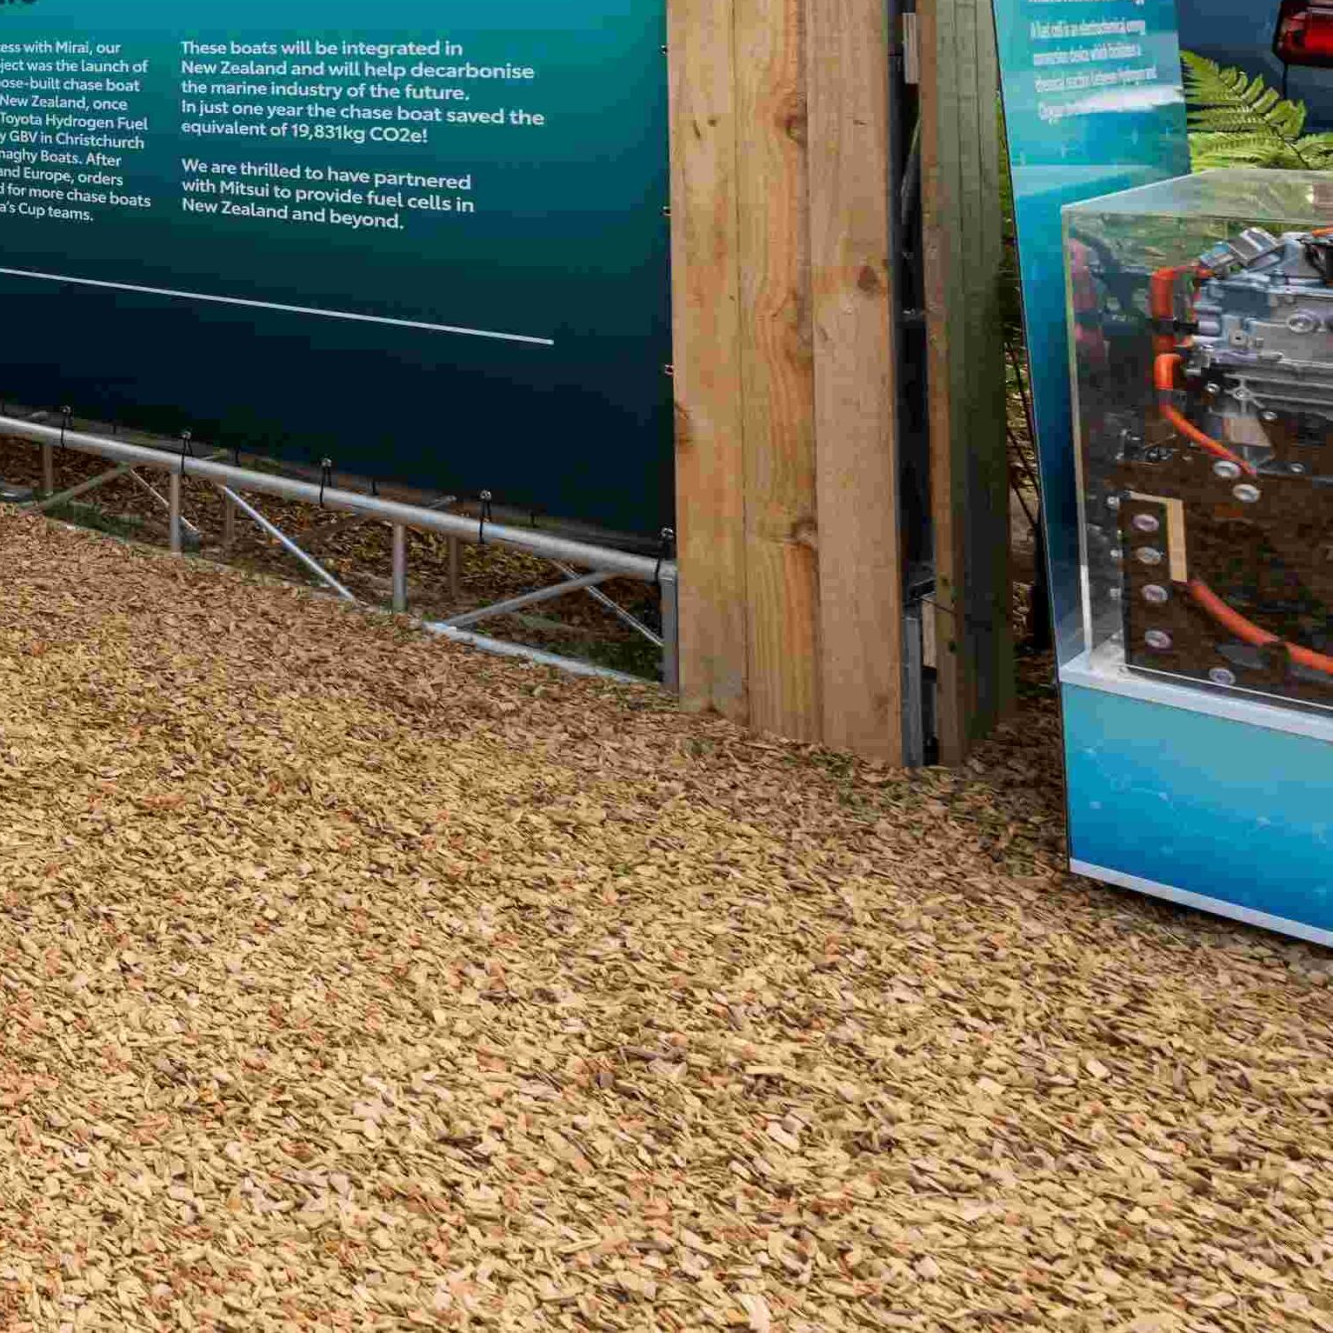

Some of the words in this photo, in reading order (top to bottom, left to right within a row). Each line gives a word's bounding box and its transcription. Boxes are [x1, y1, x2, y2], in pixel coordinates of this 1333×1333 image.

[23, 41, 53, 53] with
[55, 41, 93, 57] Mirai,
[96, 45, 122, 53] our
[181, 41, 227, 54] These
[230, 41, 277, 55] boats
[282, 41, 311, 55] will
[315, 41, 338, 55] be
[342, 41, 440, 59] integrated
[445, 43, 463, 56] in
[27, 62, 53, 71] was
[56, 60, 77, 71] the
[81, 60, 129, 72] launch
[132, 60, 149, 72] of
[181, 61, 216, 74] New
[220, 61, 287, 75] Zealand
[291, 62, 324, 75] and
[328, 62, 361, 76] will
[364, 62, 406, 81] help
[410, 63, 534, 79] decarbonise
[62, 78, 103, 91] chase
[106, 79, 141, 91] boat
[181, 80, 207, 93] the
[210, 83, 268, 95] marine
[271, 82, 342, 101] industry
[346, 84, 366, 97] of
[370, 84, 400, 98] the
[405, 85, 470, 100] future.
[0, 95, 29, 107] New
[31, 96, 91, 112] Zealand,
[93, 101, 128, 110] once
[181, 101, 196, 113] In
[198, 103, 229, 117] just
[232, 105, 263, 115] one
[267, 106, 303, 120] year
[307, 104, 336, 118] the
[340, 105, 393, 120] chase
[397, 106, 442, 121] boat
[446, 109, 504, 123] saved
[509, 109, 545, 124] the
[45, 114, 114, 131] Hydrogen
[117, 117, 149, 130] Fuel
[9, 131, 38, 143] GBV
[40, 133, 52, 144] in
[55, 133, 145, 149] Christchurch
[181, 123, 267, 137] equivalent
[270, 124, 289, 137] of
[291, 125, 365, 144] 19,831kg
[369, 127, 429, 143] CO2e!
[40, 150, 82, 164] Boats.
[85, 153, 123, 166] After
[23, 167, 75, 185] Europe,
[78, 172, 124, 185] orders
[181, 159, 208, 173] We
[211, 164, 237, 174] are
[240, 163, 301, 179] thrilled
[305, 168, 323, 180] to
[327, 167, 370, 183] have
[374, 174, 471, 190] partnered
[7, 184, 26, 196] for
[28, 189, 64, 199] more
[66, 189, 107, 203] chase
[109, 192, 151, 206] boats
[181, 181, 215, 194] with
[219, 182, 270, 198] Mitsui
[273, 187, 292, 199] to
[295, 190, 363, 204] provide
[366, 191, 403, 207] fuel
[407, 196, 452, 211] cells
[456, 199, 474, 212] in
[18, 203, 45, 219] Cup
[48, 206, 94, 220] teams.
[181, 199, 218, 214] New
[221, 202, 289, 219] Zealand
[292, 209, 325, 222] and
[329, 210, 405, 229] beyond.
